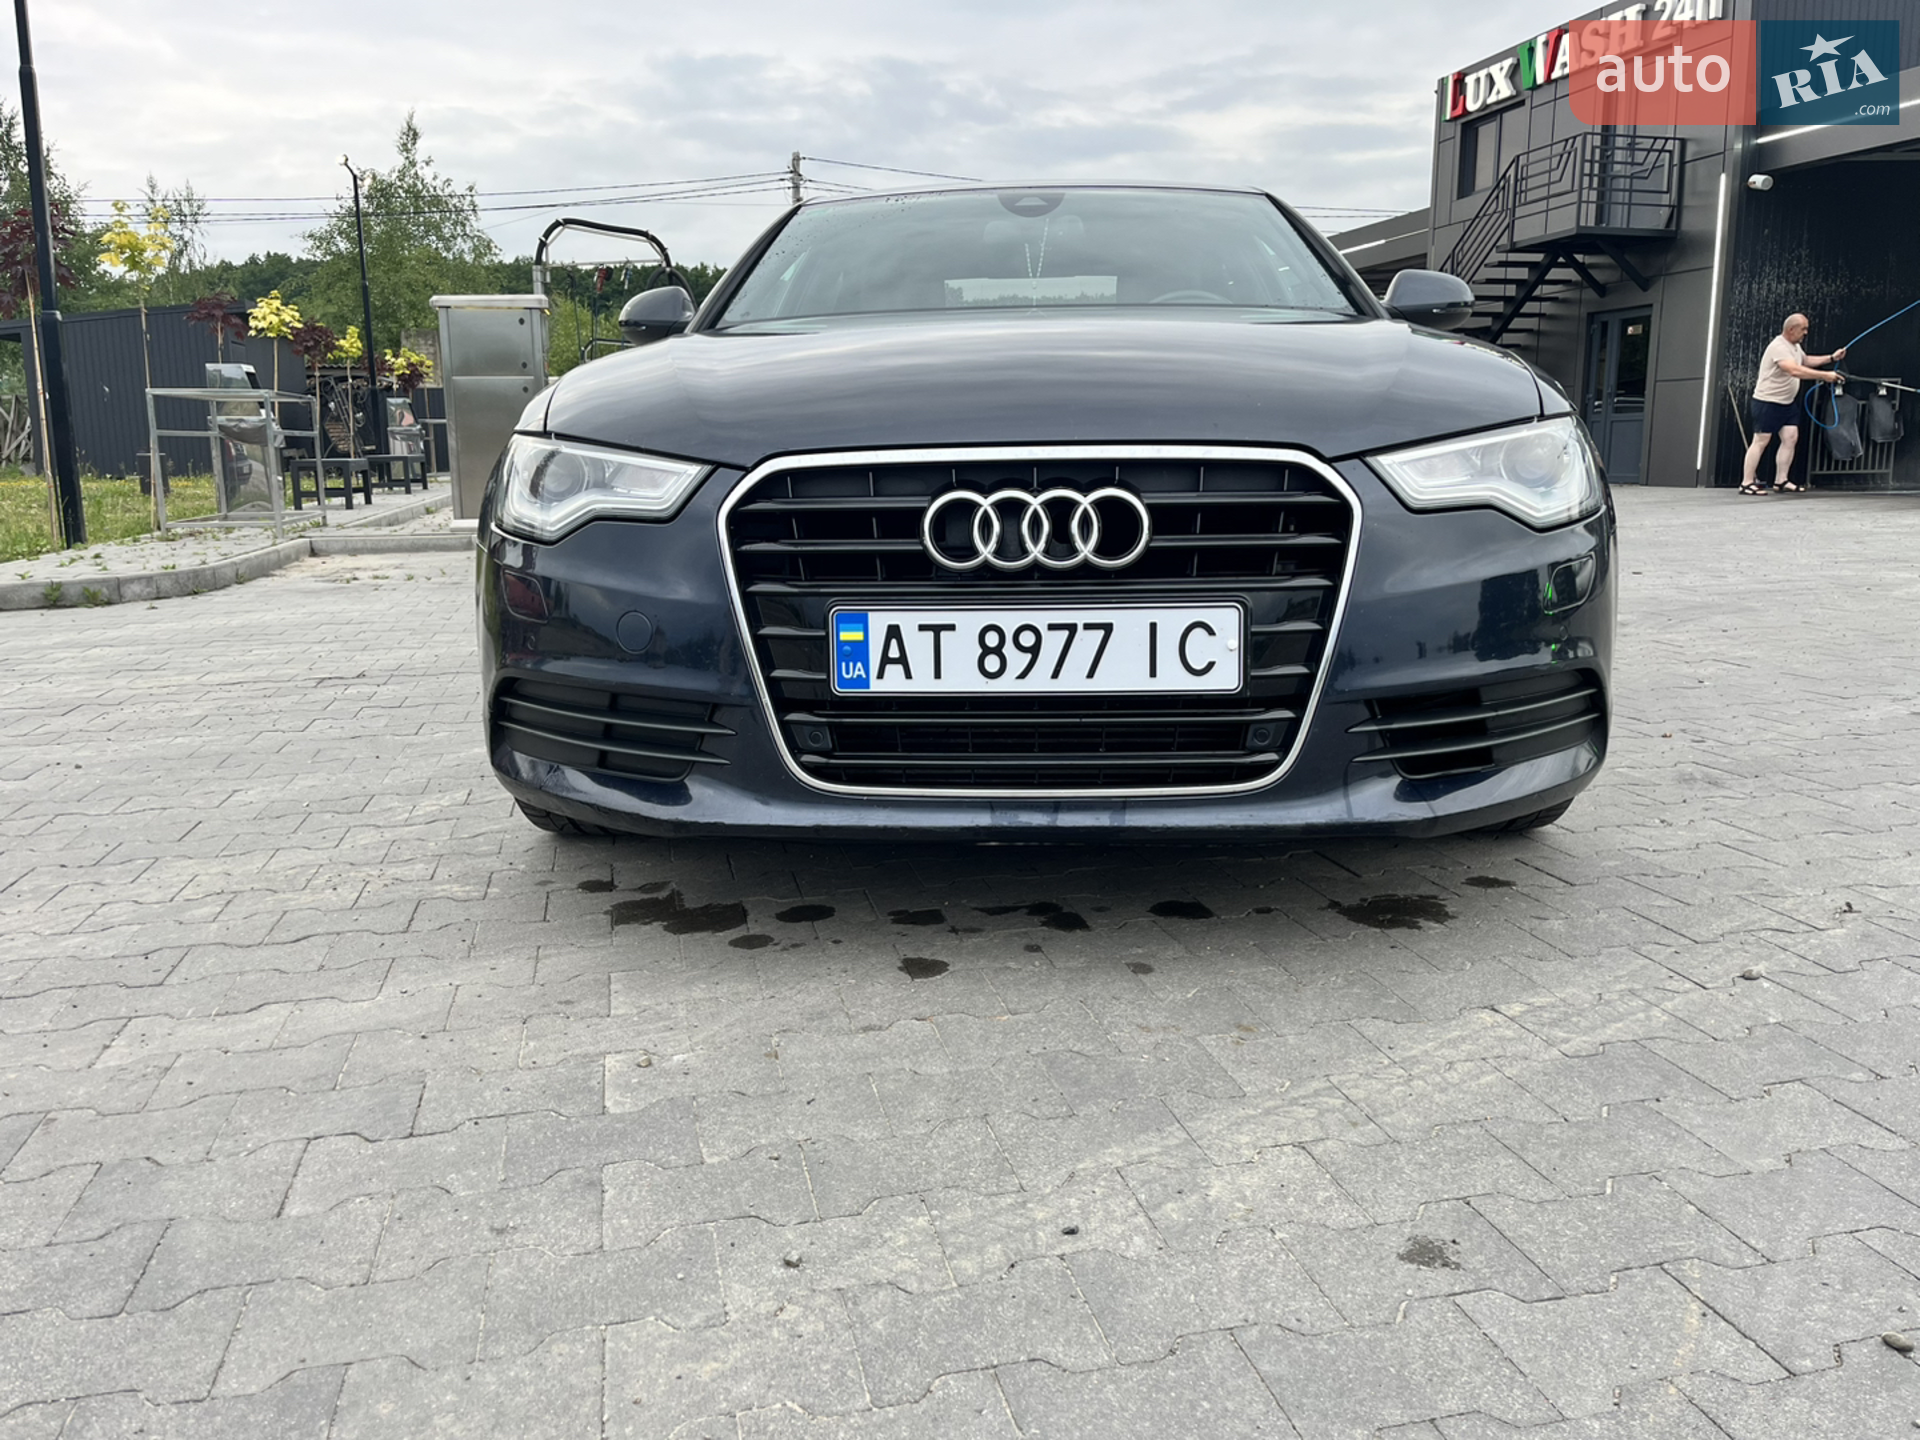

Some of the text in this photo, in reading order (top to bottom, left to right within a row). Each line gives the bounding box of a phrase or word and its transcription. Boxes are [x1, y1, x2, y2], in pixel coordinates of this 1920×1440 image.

[1442, 57, 1518, 122] LUX
[841, 662, 866, 678] UA
[876, 620, 1217, 679] AT 8977 IC
